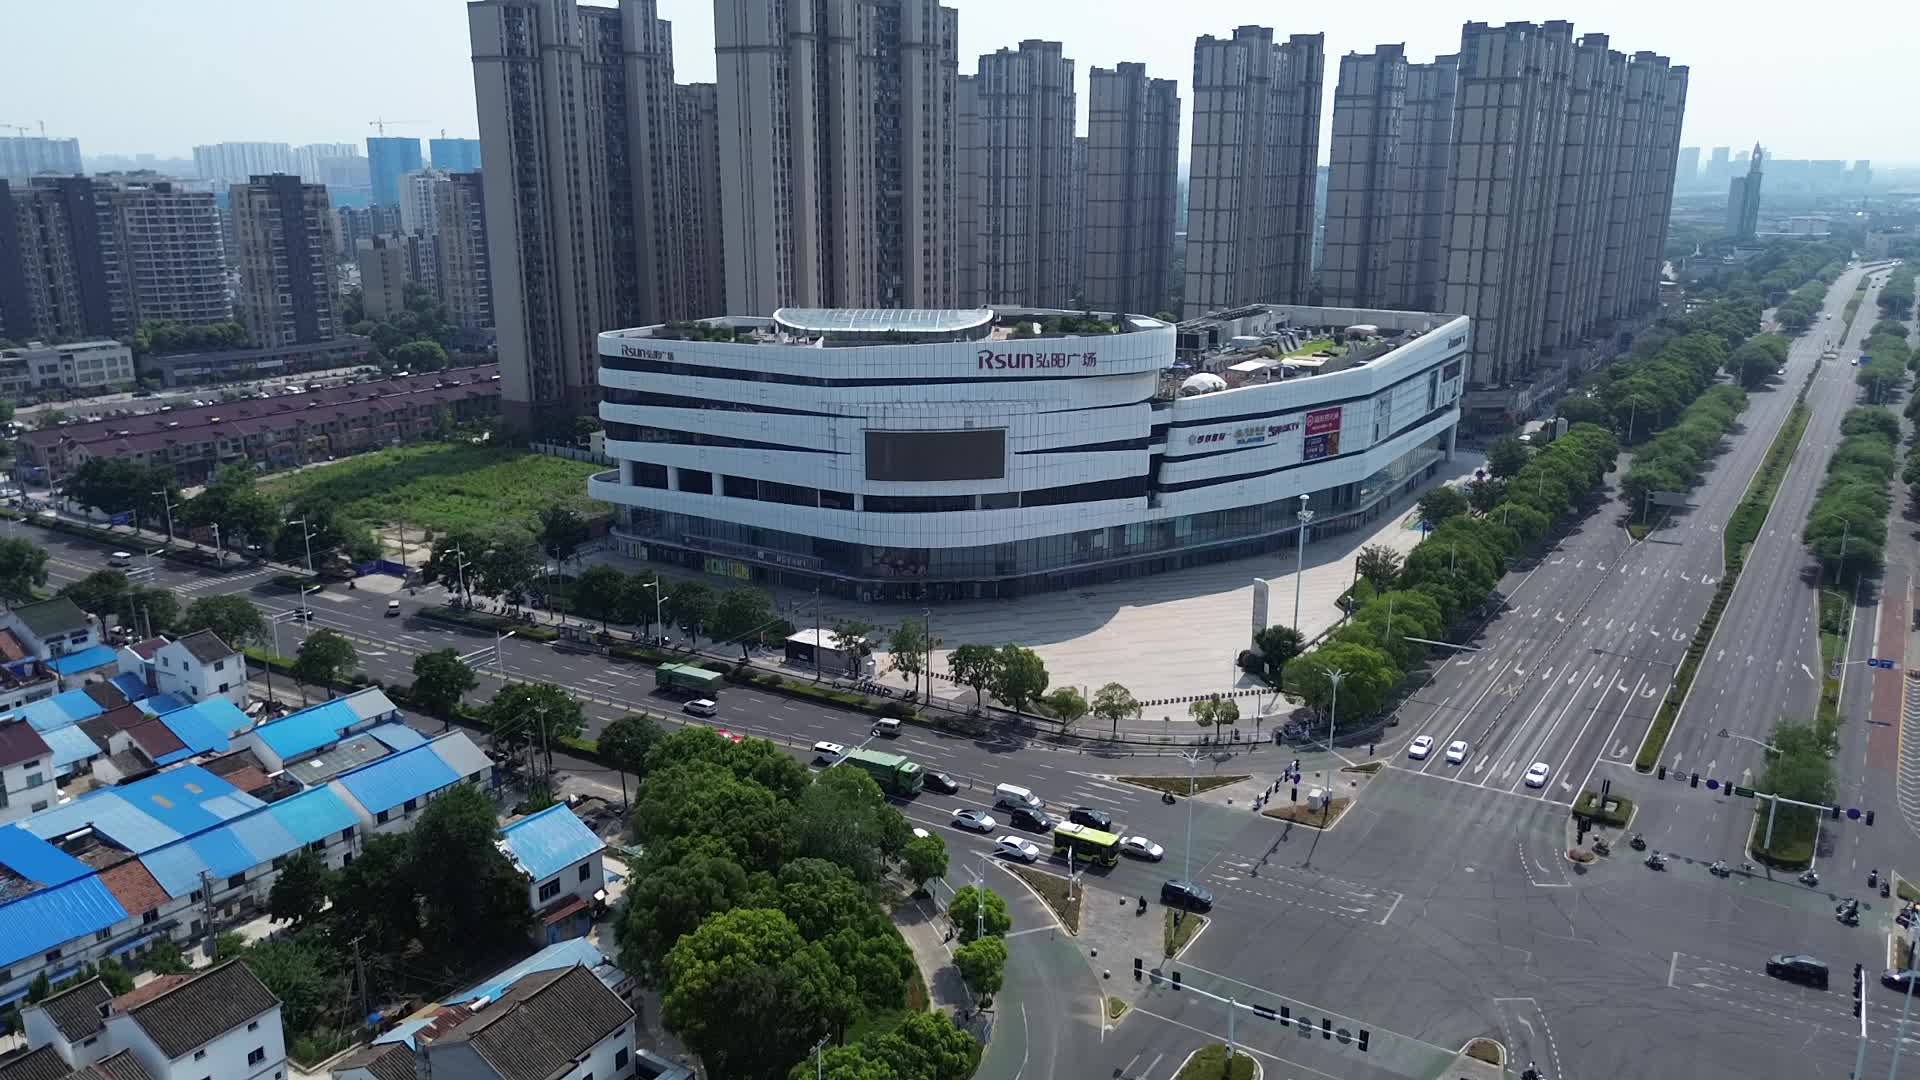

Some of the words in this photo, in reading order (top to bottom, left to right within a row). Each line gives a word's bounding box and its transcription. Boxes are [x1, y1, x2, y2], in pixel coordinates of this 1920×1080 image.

[977, 349, 1034, 369] Rsun
[1036, 352, 1097, 368] 弘阳广场
